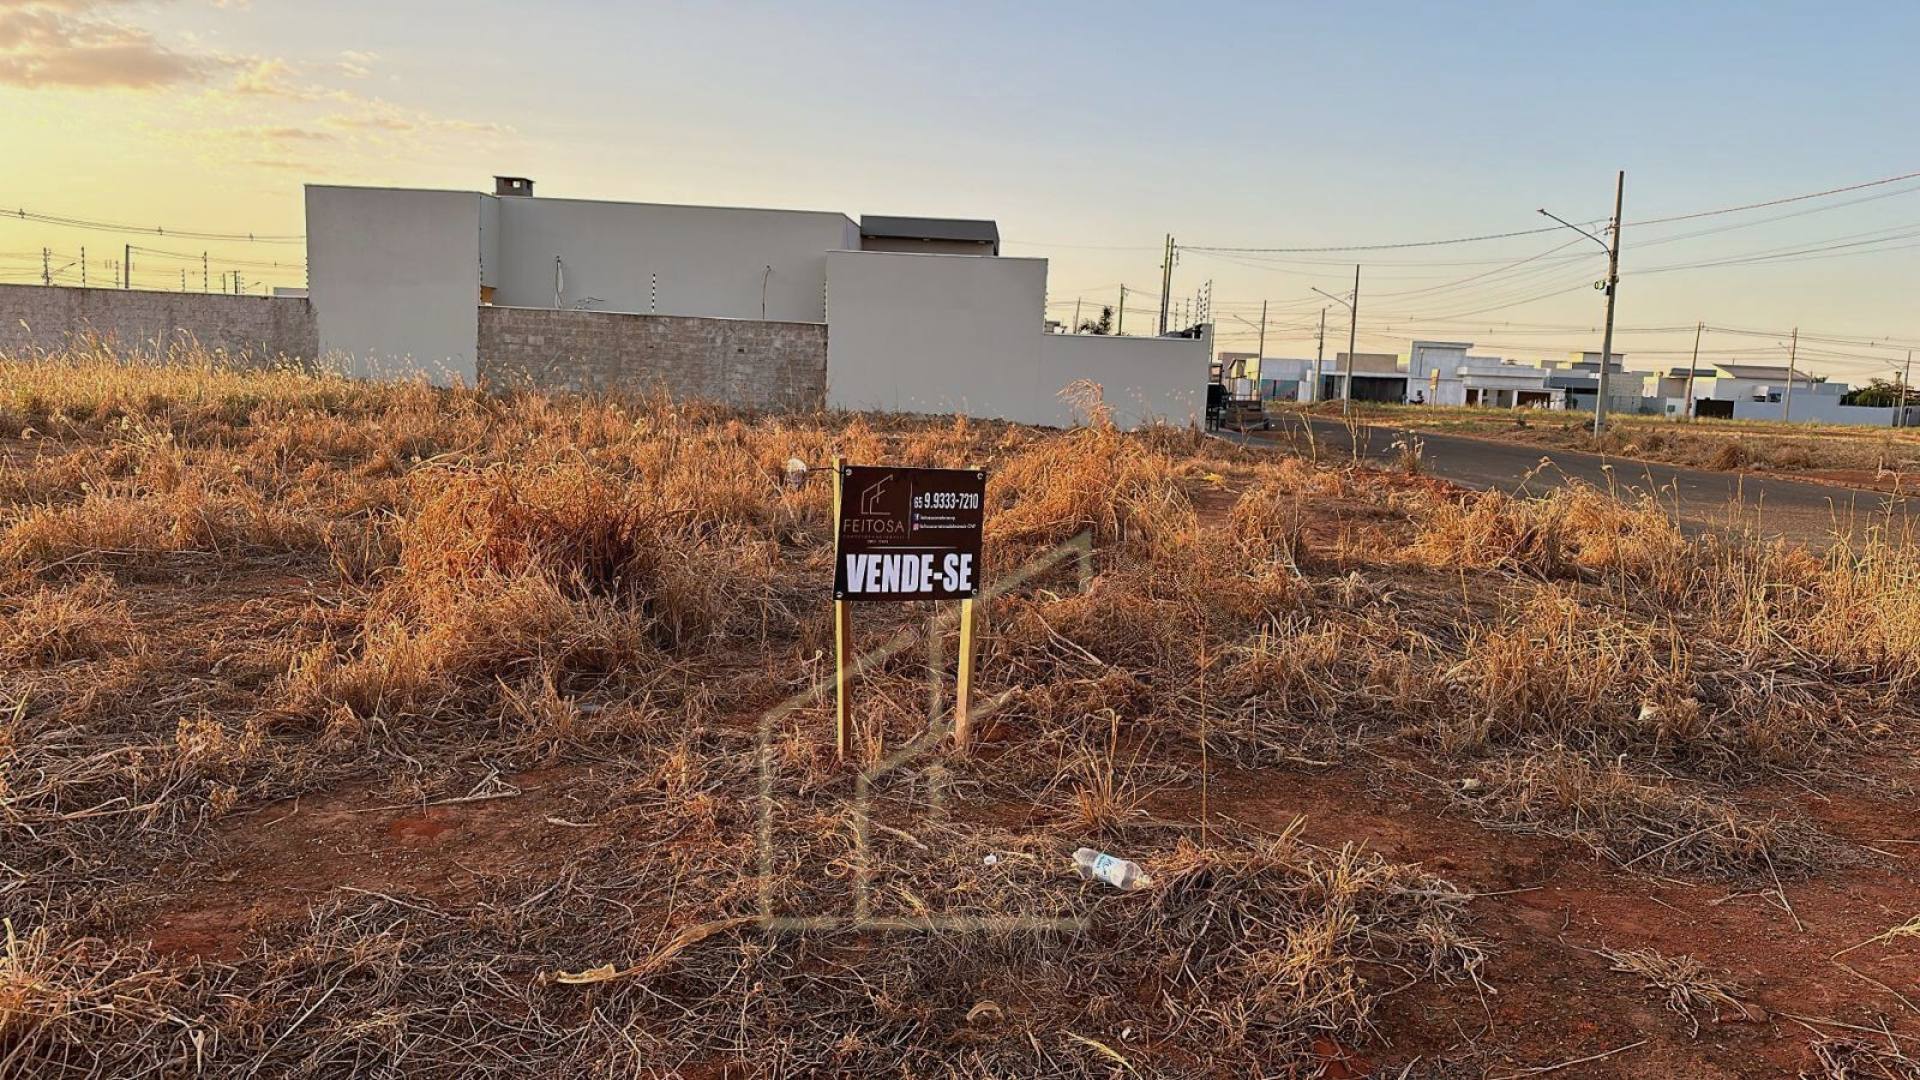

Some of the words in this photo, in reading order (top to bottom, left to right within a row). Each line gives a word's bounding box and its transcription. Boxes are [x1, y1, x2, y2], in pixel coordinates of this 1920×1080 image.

[914, 496, 923, 509] 65
[924, 492, 979, 509] 9.9333-7210
[843, 519, 905, 533] FEITOSA
[846, 553, 973, 593] VENDE-SE
